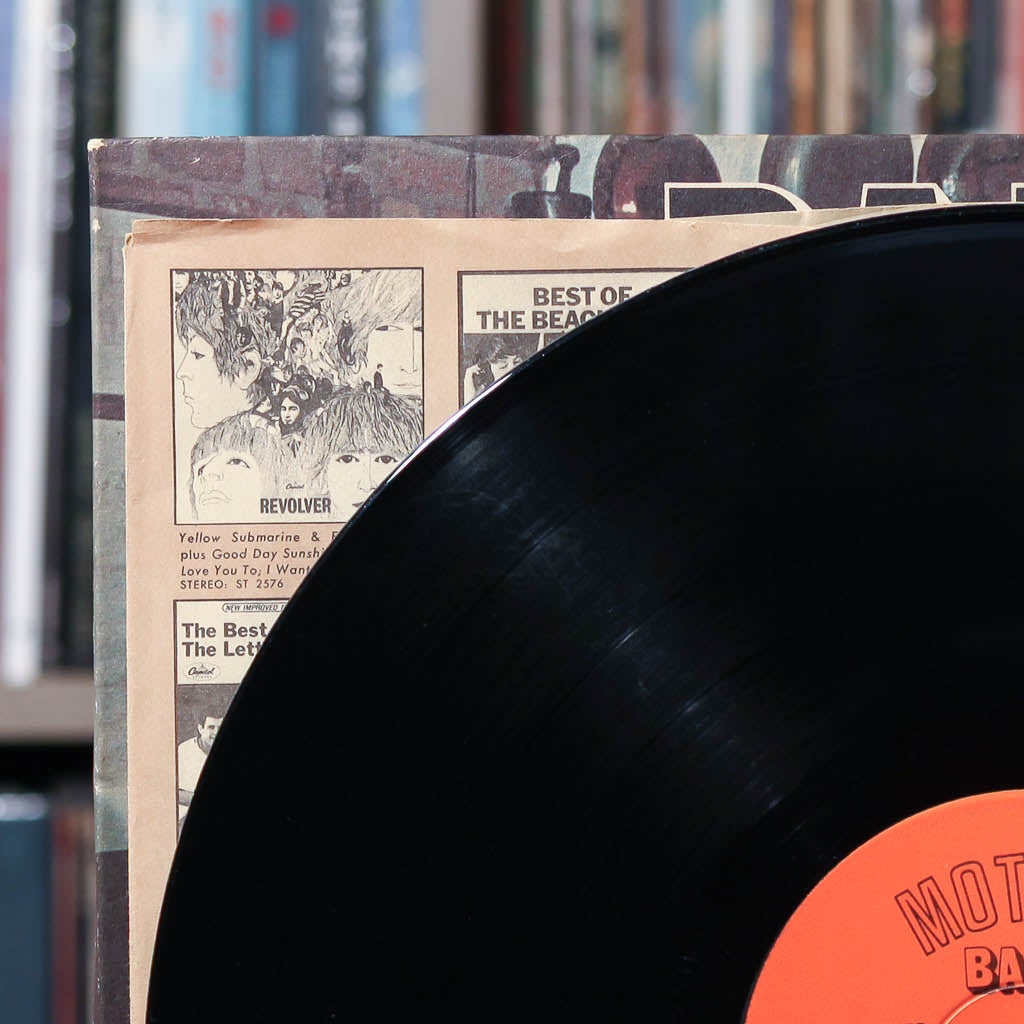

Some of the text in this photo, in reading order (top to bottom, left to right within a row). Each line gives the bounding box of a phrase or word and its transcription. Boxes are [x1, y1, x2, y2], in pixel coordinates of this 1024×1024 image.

[534, 287, 632, 306] BEST OF
[476, 310, 603, 329] THE BEAC
[260, 498, 331, 514] REVOLVER
[180, 532, 320, 543] Yellow Submarine &
[181, 548, 277, 562] plus Good Day
[182, 566, 208, 576] Love
[215, 565, 237, 575] You
[243, 565, 261, 576] To;
[181, 579, 283, 589] STEREO: ST 2576
[182, 623, 267, 638] The Best
[182, 642, 216, 657] The
